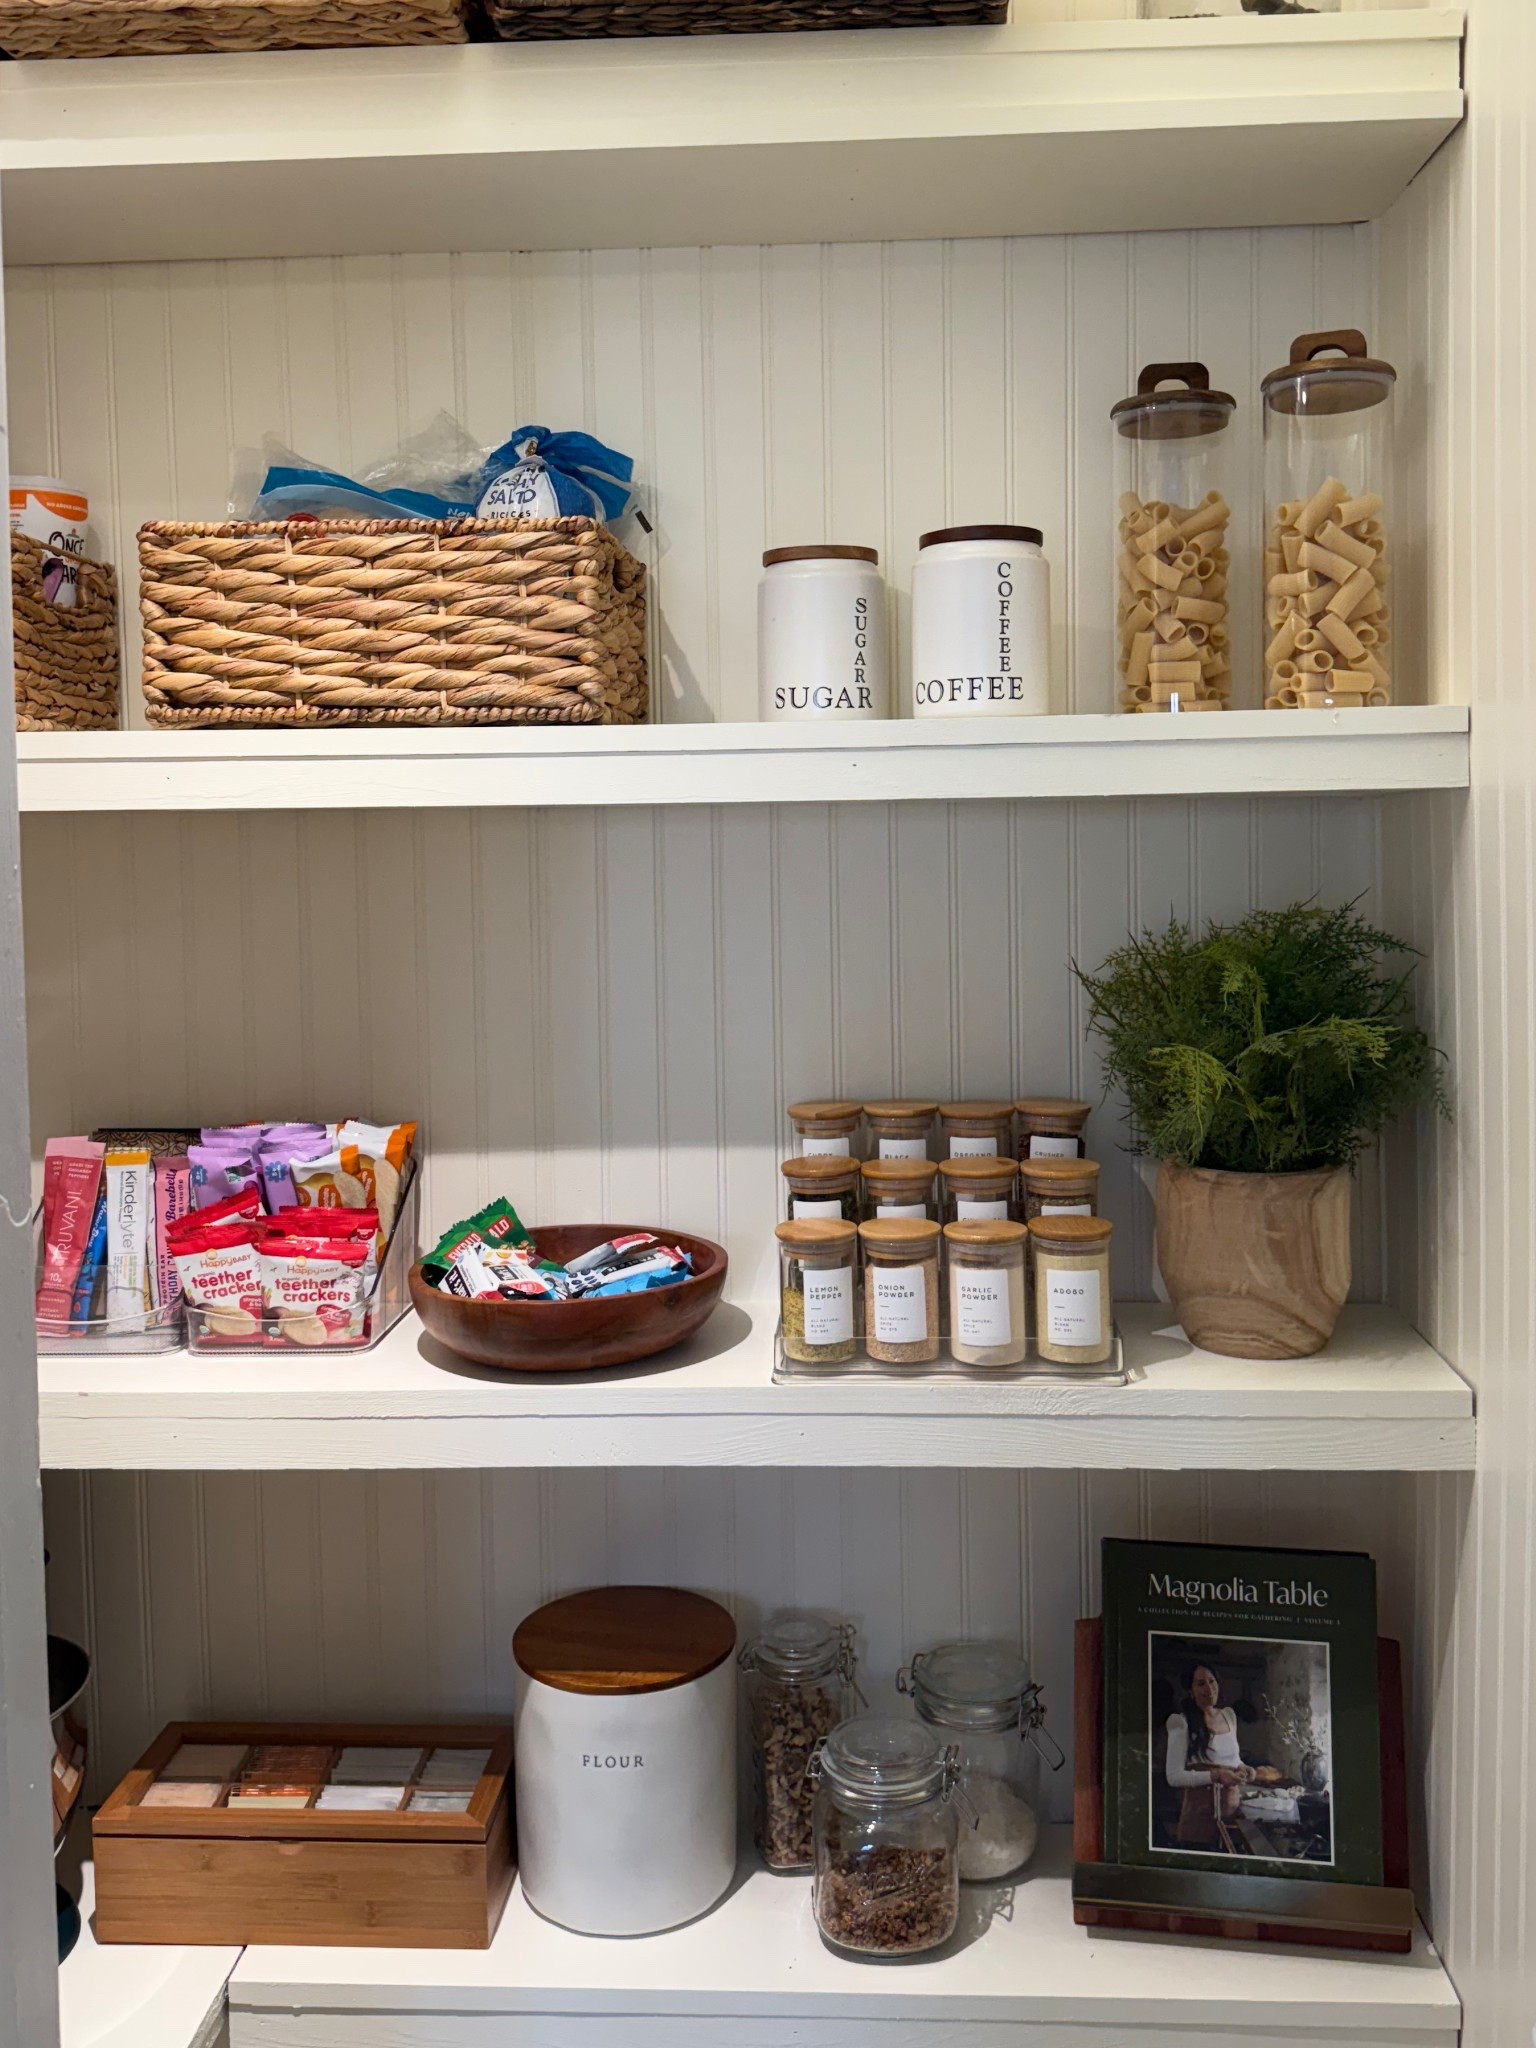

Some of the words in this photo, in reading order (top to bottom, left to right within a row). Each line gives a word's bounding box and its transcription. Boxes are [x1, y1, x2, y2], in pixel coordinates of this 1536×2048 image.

[997, 562, 1013, 672] COFFEE
[854, 597, 868, 684] SUGAR
[775, 686, 873, 709] SUGAR
[916, 676, 1024, 705] COFFEE
[164, 1168, 178, 1221] Barebells
[191, 1269, 253, 1290] teether
[203, 1280, 262, 1299] cracker
[275, 1279, 337, 1291] teether
[283, 1288, 351, 1302] crackers
[810, 1292, 842, 1300] PEPPER
[1053, 1287, 1085, 1295] ADOBO
[1148, 1573, 1259, 1606] Magnolia
[1263, 1580, 1328, 1607] Table
[1143, 1607, 1188, 1615] COLLECTION
[1251, 1614, 1293, 1623] GATHERING
[583, 1755, 644, 1768] FLOUR
